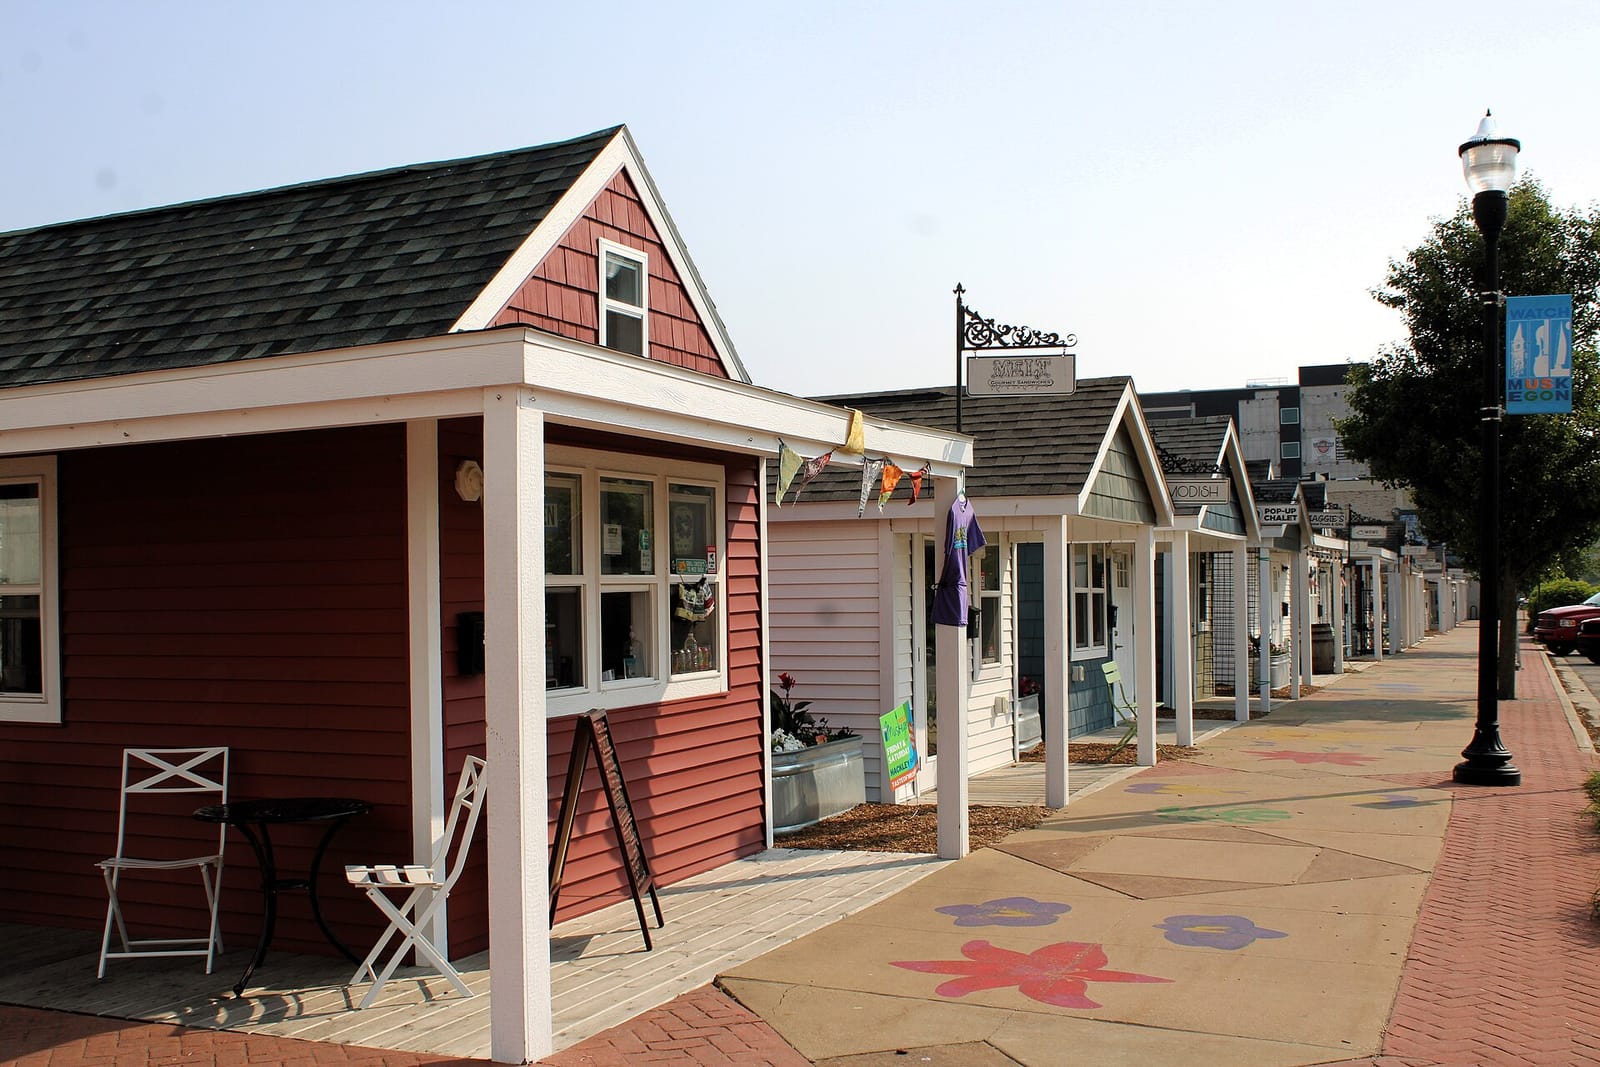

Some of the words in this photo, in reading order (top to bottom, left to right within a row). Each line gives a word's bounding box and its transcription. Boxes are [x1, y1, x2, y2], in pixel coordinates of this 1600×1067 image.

[1510, 307, 1569, 320] WATCH
[991, 359, 1052, 379] MELT
[1508, 378, 1569, 390] MUSK
[1508, 390, 1569, 402] EGON
[1264, 507, 1297, 515] POP-UP
[1264, 514, 1298, 522] CHALET
